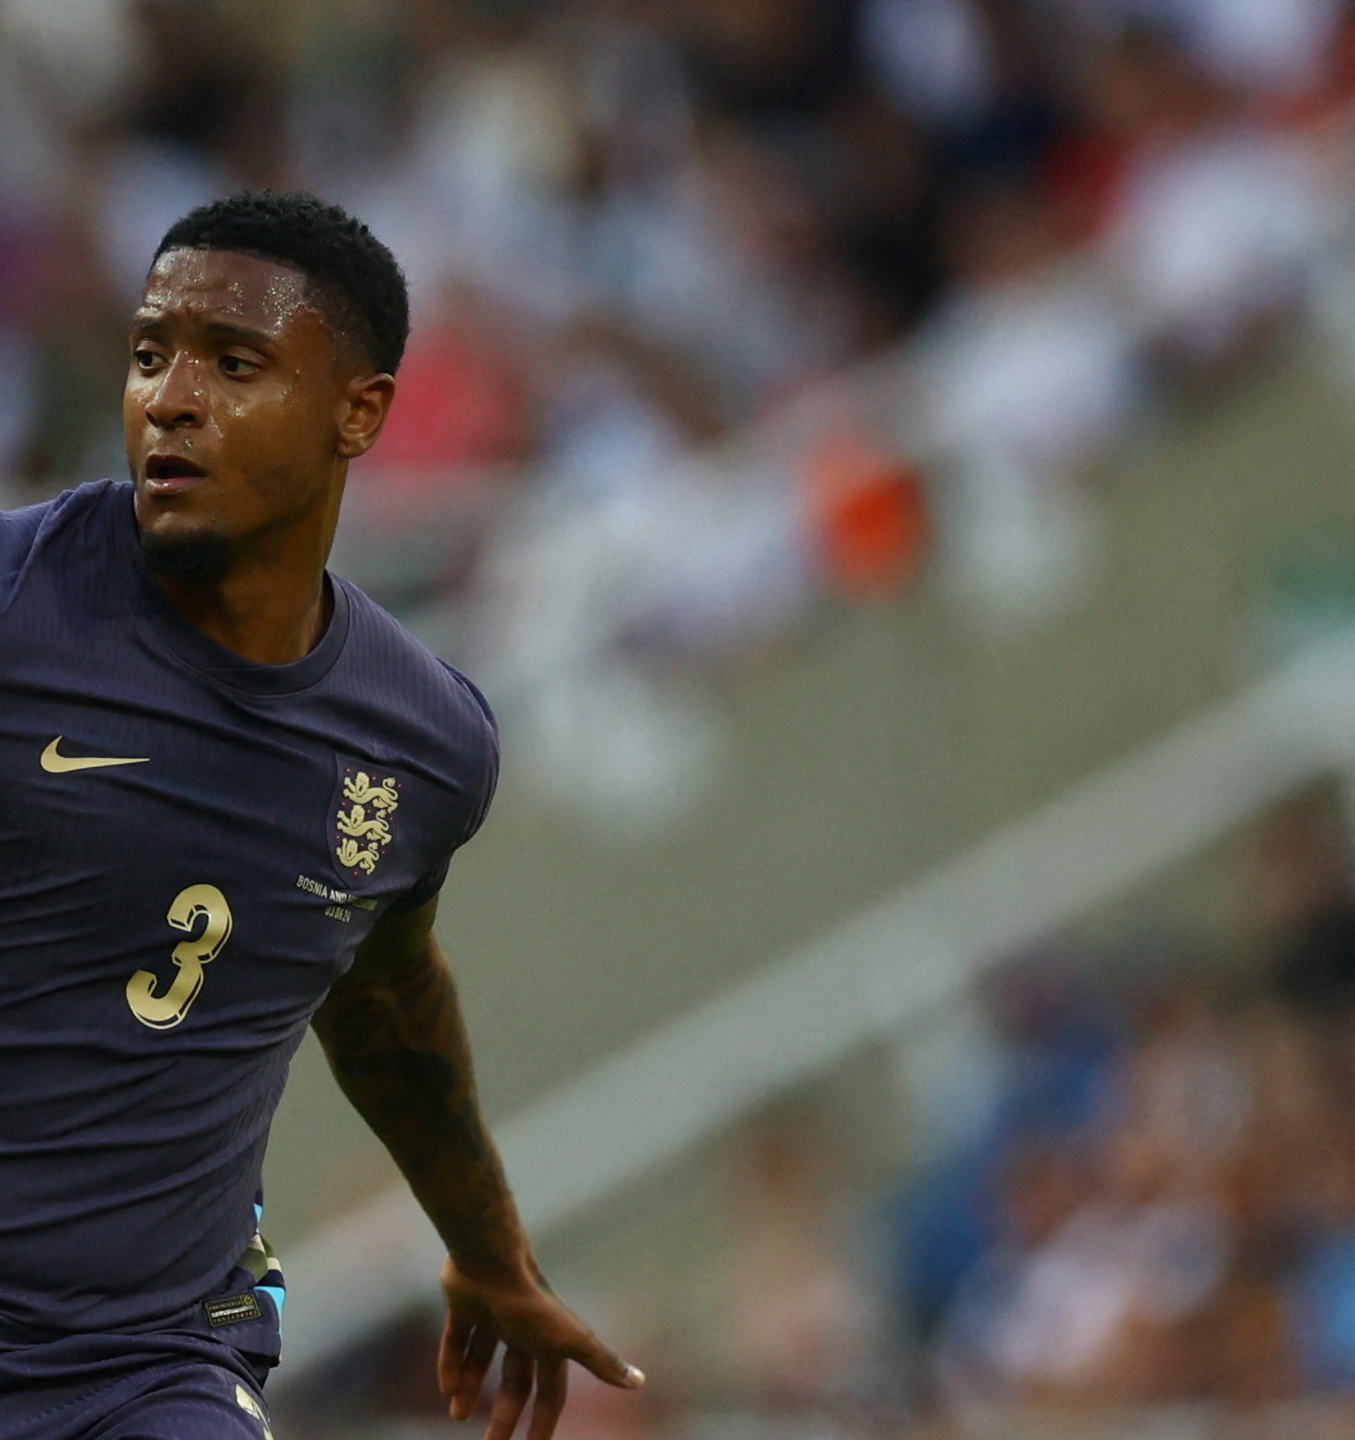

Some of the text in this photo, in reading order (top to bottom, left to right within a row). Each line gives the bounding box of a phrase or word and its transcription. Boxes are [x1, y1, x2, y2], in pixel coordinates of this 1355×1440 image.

[296, 875, 328, 899] BOSNIA
[330, 889, 347, 904] AND
[125, 883, 233, 1031] 3
